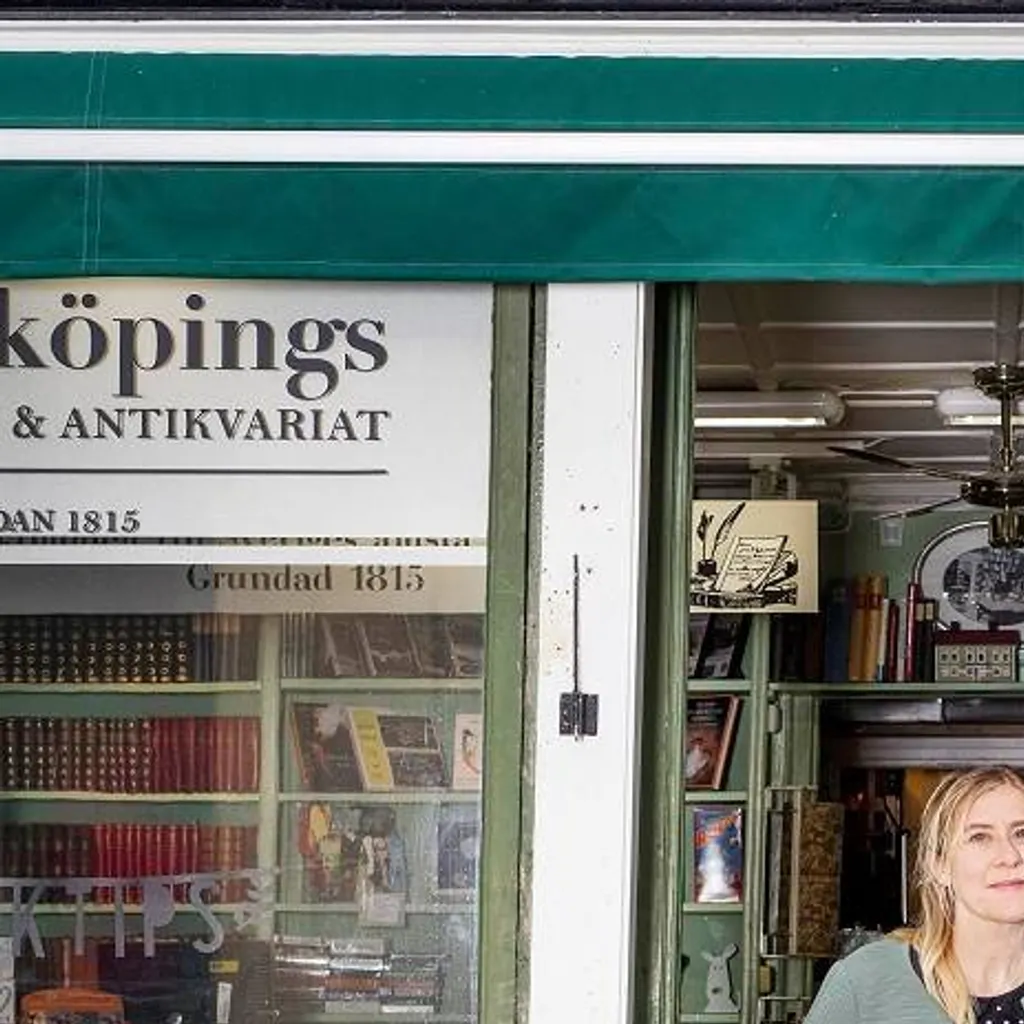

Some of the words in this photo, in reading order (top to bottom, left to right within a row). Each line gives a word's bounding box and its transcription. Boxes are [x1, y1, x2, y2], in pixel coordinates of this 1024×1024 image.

[13, 405, 46, 440] &
[60, 408, 391, 442] ANTIKVARIAT
[67, 509, 141, 534] 1815
[187, 564, 333, 593] Grundad
[350, 564, 425, 593] 1815
